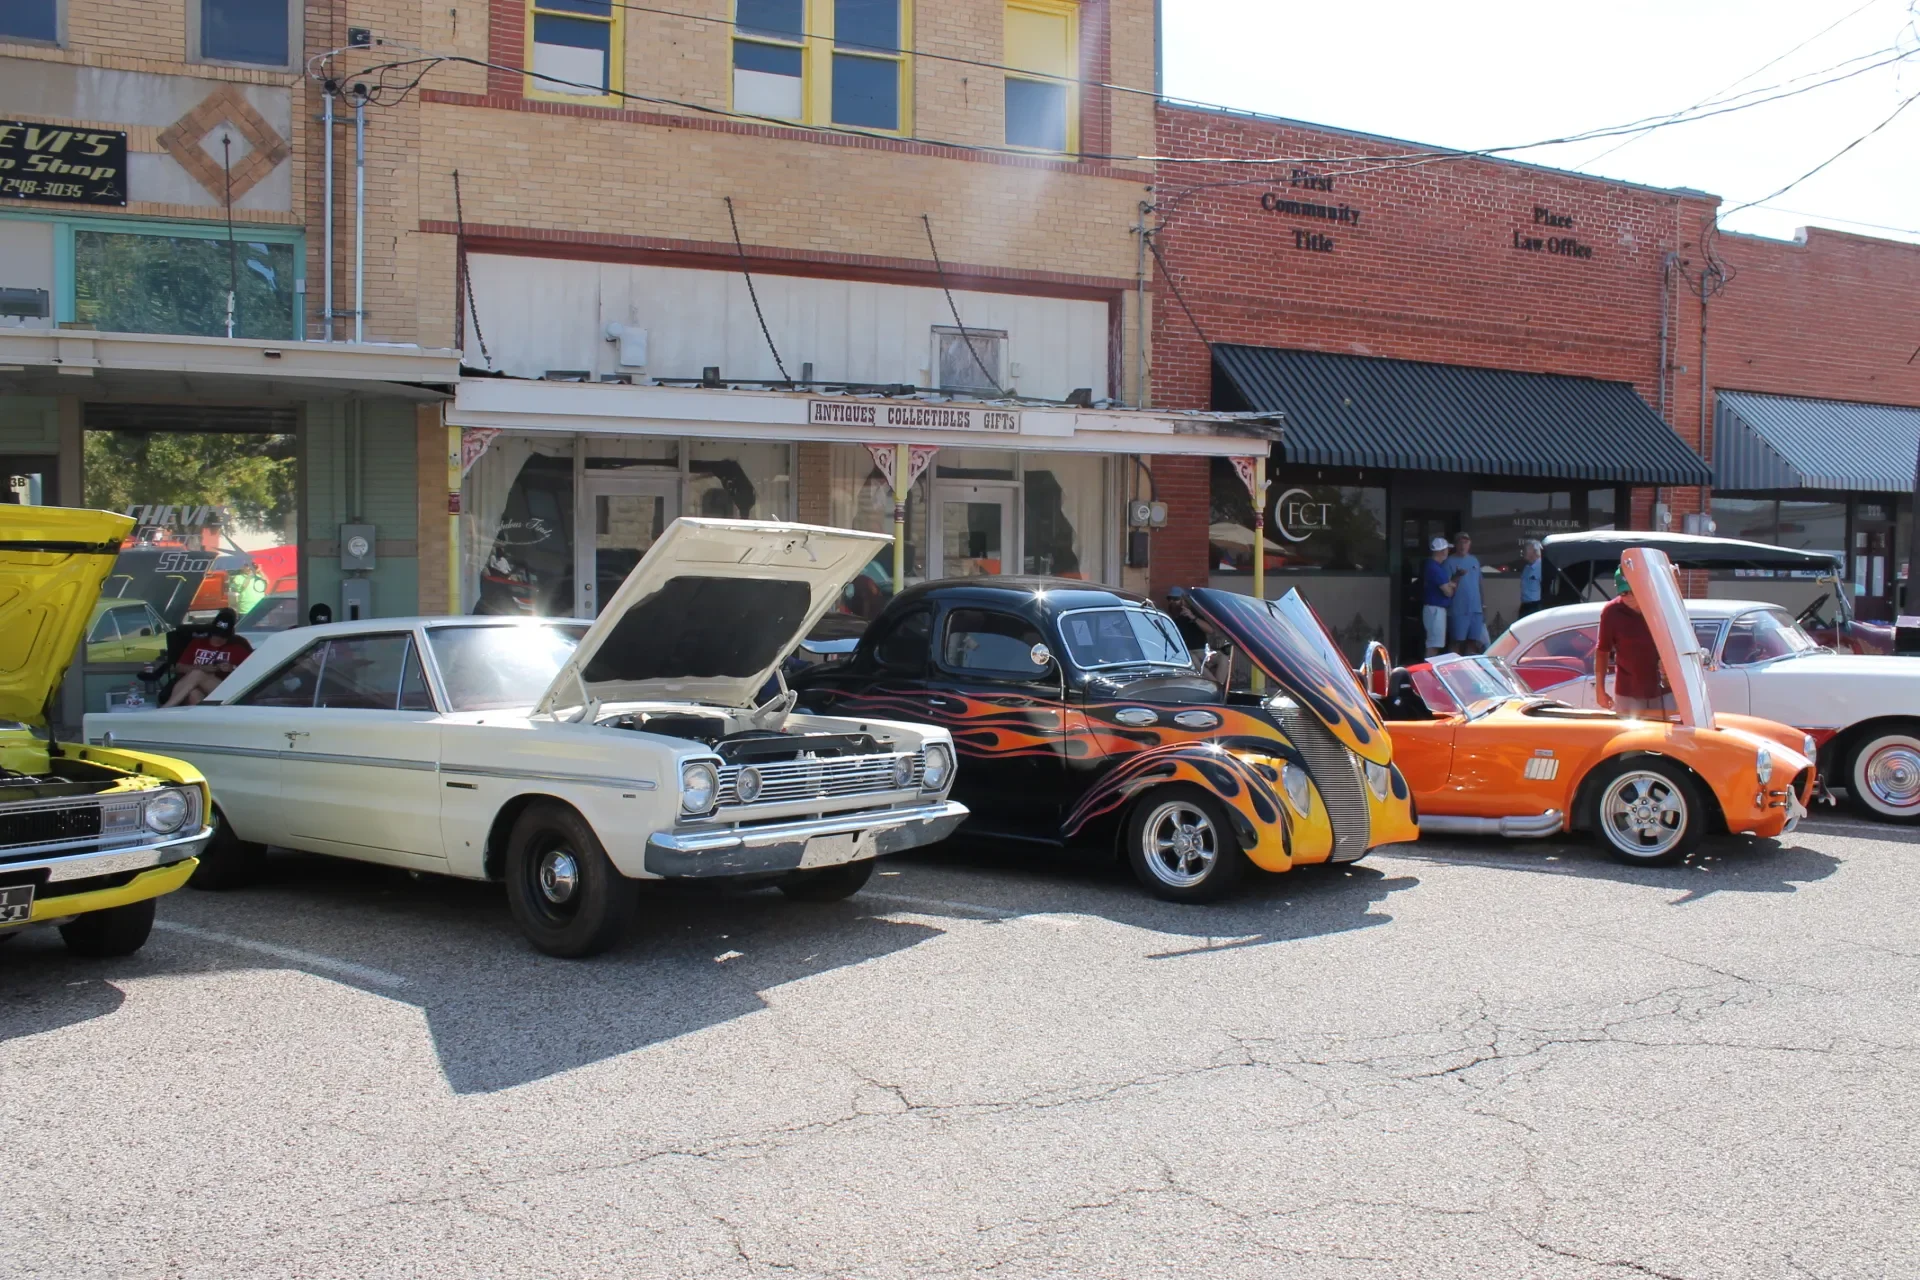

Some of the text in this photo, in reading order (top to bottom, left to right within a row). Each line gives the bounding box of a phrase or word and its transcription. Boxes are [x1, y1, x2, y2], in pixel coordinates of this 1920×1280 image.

[22, 154, 117, 180] Shop
[2, 178, 85, 198] 248-3035
[1291, 168, 1333, 192] First
[1261, 192, 1361, 227] Community
[1533, 207, 1573, 229] Place
[1291, 230, 1333, 253] Title
[1513, 229, 1592, 259] Law Office
[814, 403, 876, 424] ANTIQUES
[887, 407, 971, 429] COLLECTIBLES
